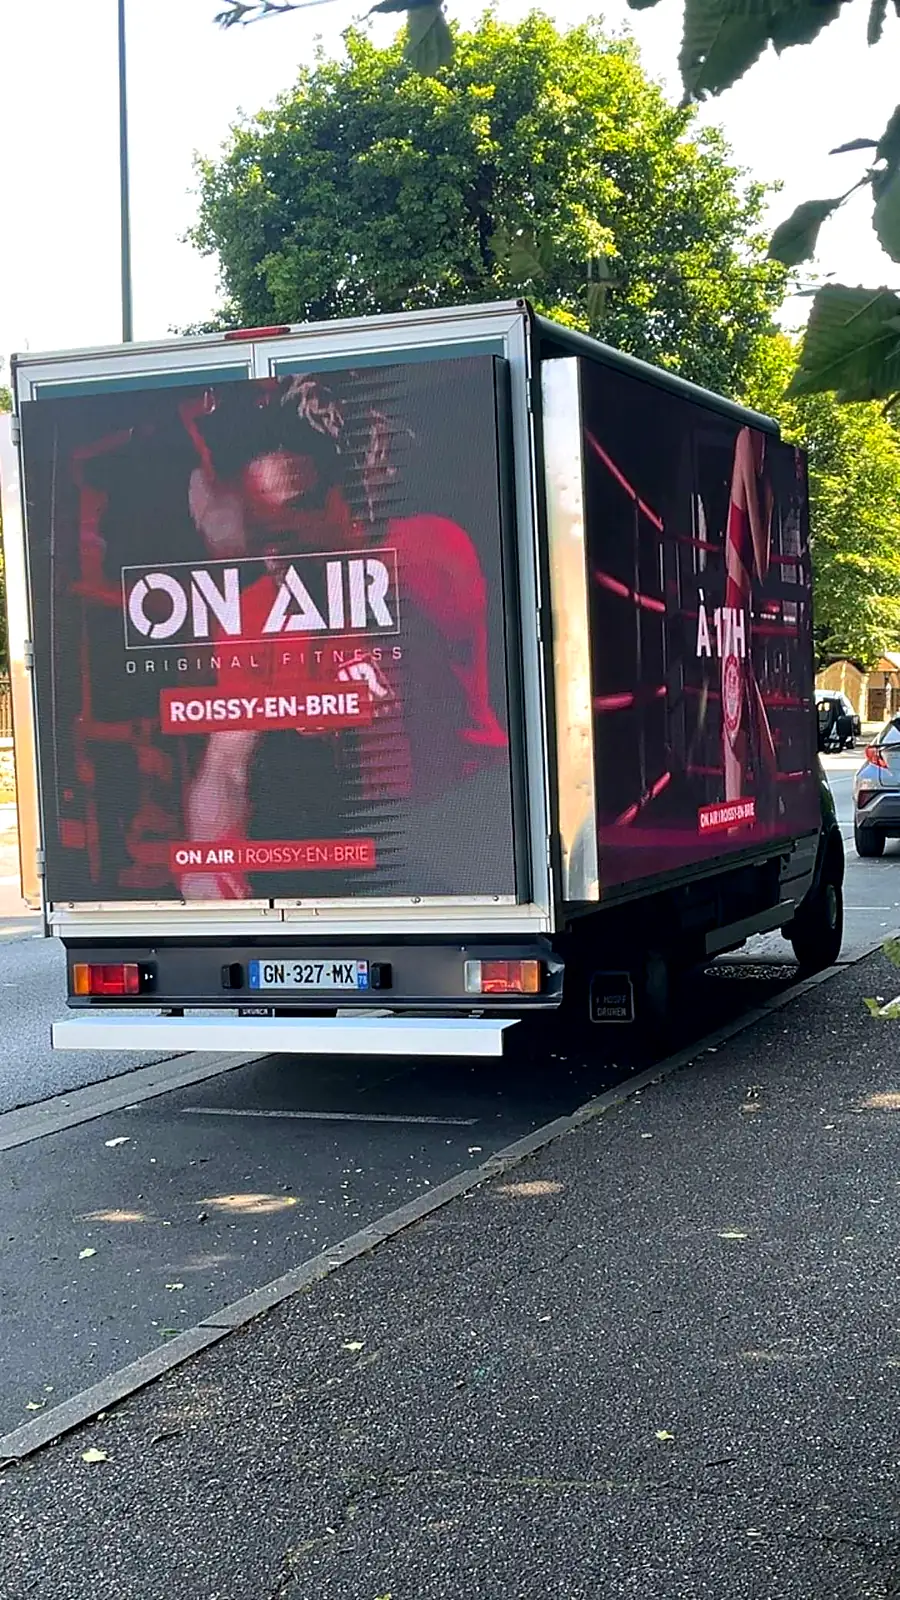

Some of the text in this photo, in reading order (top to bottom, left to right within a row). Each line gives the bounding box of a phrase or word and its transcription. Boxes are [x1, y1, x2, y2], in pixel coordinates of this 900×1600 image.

[128, 557, 394, 640] ON AIR
[696, 587, 712, 658] À
[125, 645, 403, 674] ORIGINAL FITNESS
[169, 692, 360, 723] ROISSY-EN-BRIE
[175, 845, 369, 865] ON AIR ROISSY-EN-BRIE
[263, 963, 354, 984] GN-327-MX
